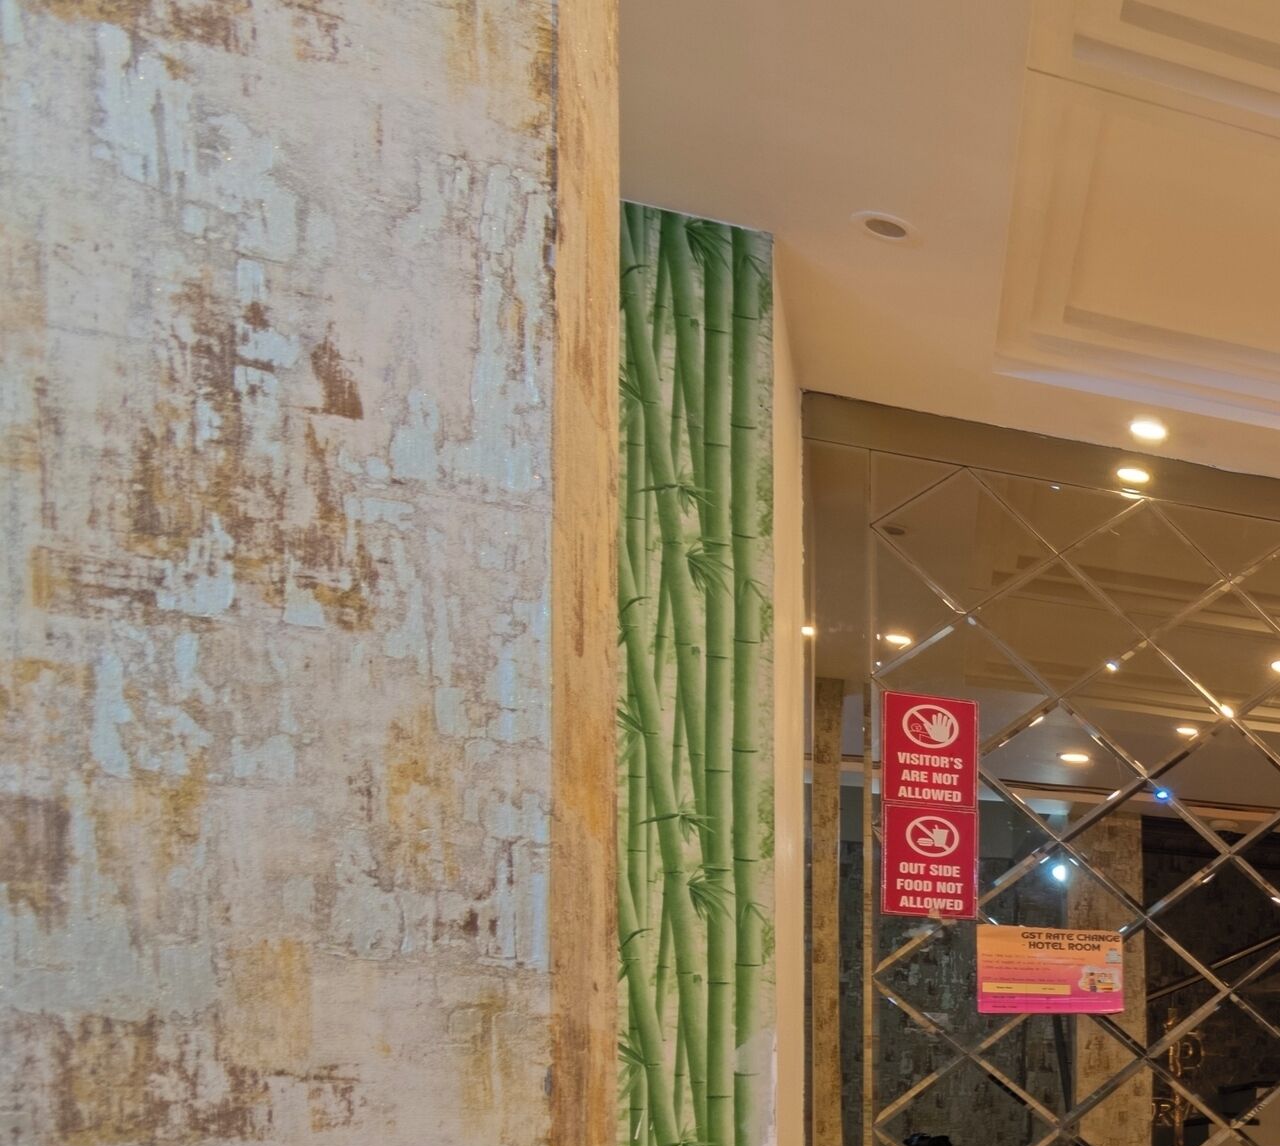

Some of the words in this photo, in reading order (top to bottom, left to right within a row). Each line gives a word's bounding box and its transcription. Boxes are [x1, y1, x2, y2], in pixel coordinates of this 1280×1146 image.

[897, 752, 963, 769] VISITOR'S
[901, 770, 928, 783] ARE
[932, 772, 959, 785] NOT
[898, 786, 962, 802] ALLOWED
[899, 862, 926, 875] OUT
[929, 864, 960, 877] SIDE
[896, 879, 932, 892] FOOD
[936, 881, 964, 894] NOT
[899, 896, 964, 911] ALLOWED
[1021, 932, 1043, 940] GST
[1045, 932, 1074, 941] RATE
[1076, 934, 1121, 943] CHANGE
[1028, 941, 1065, 950] HOTEL
[1068, 943, 1101, 952] ROOM
